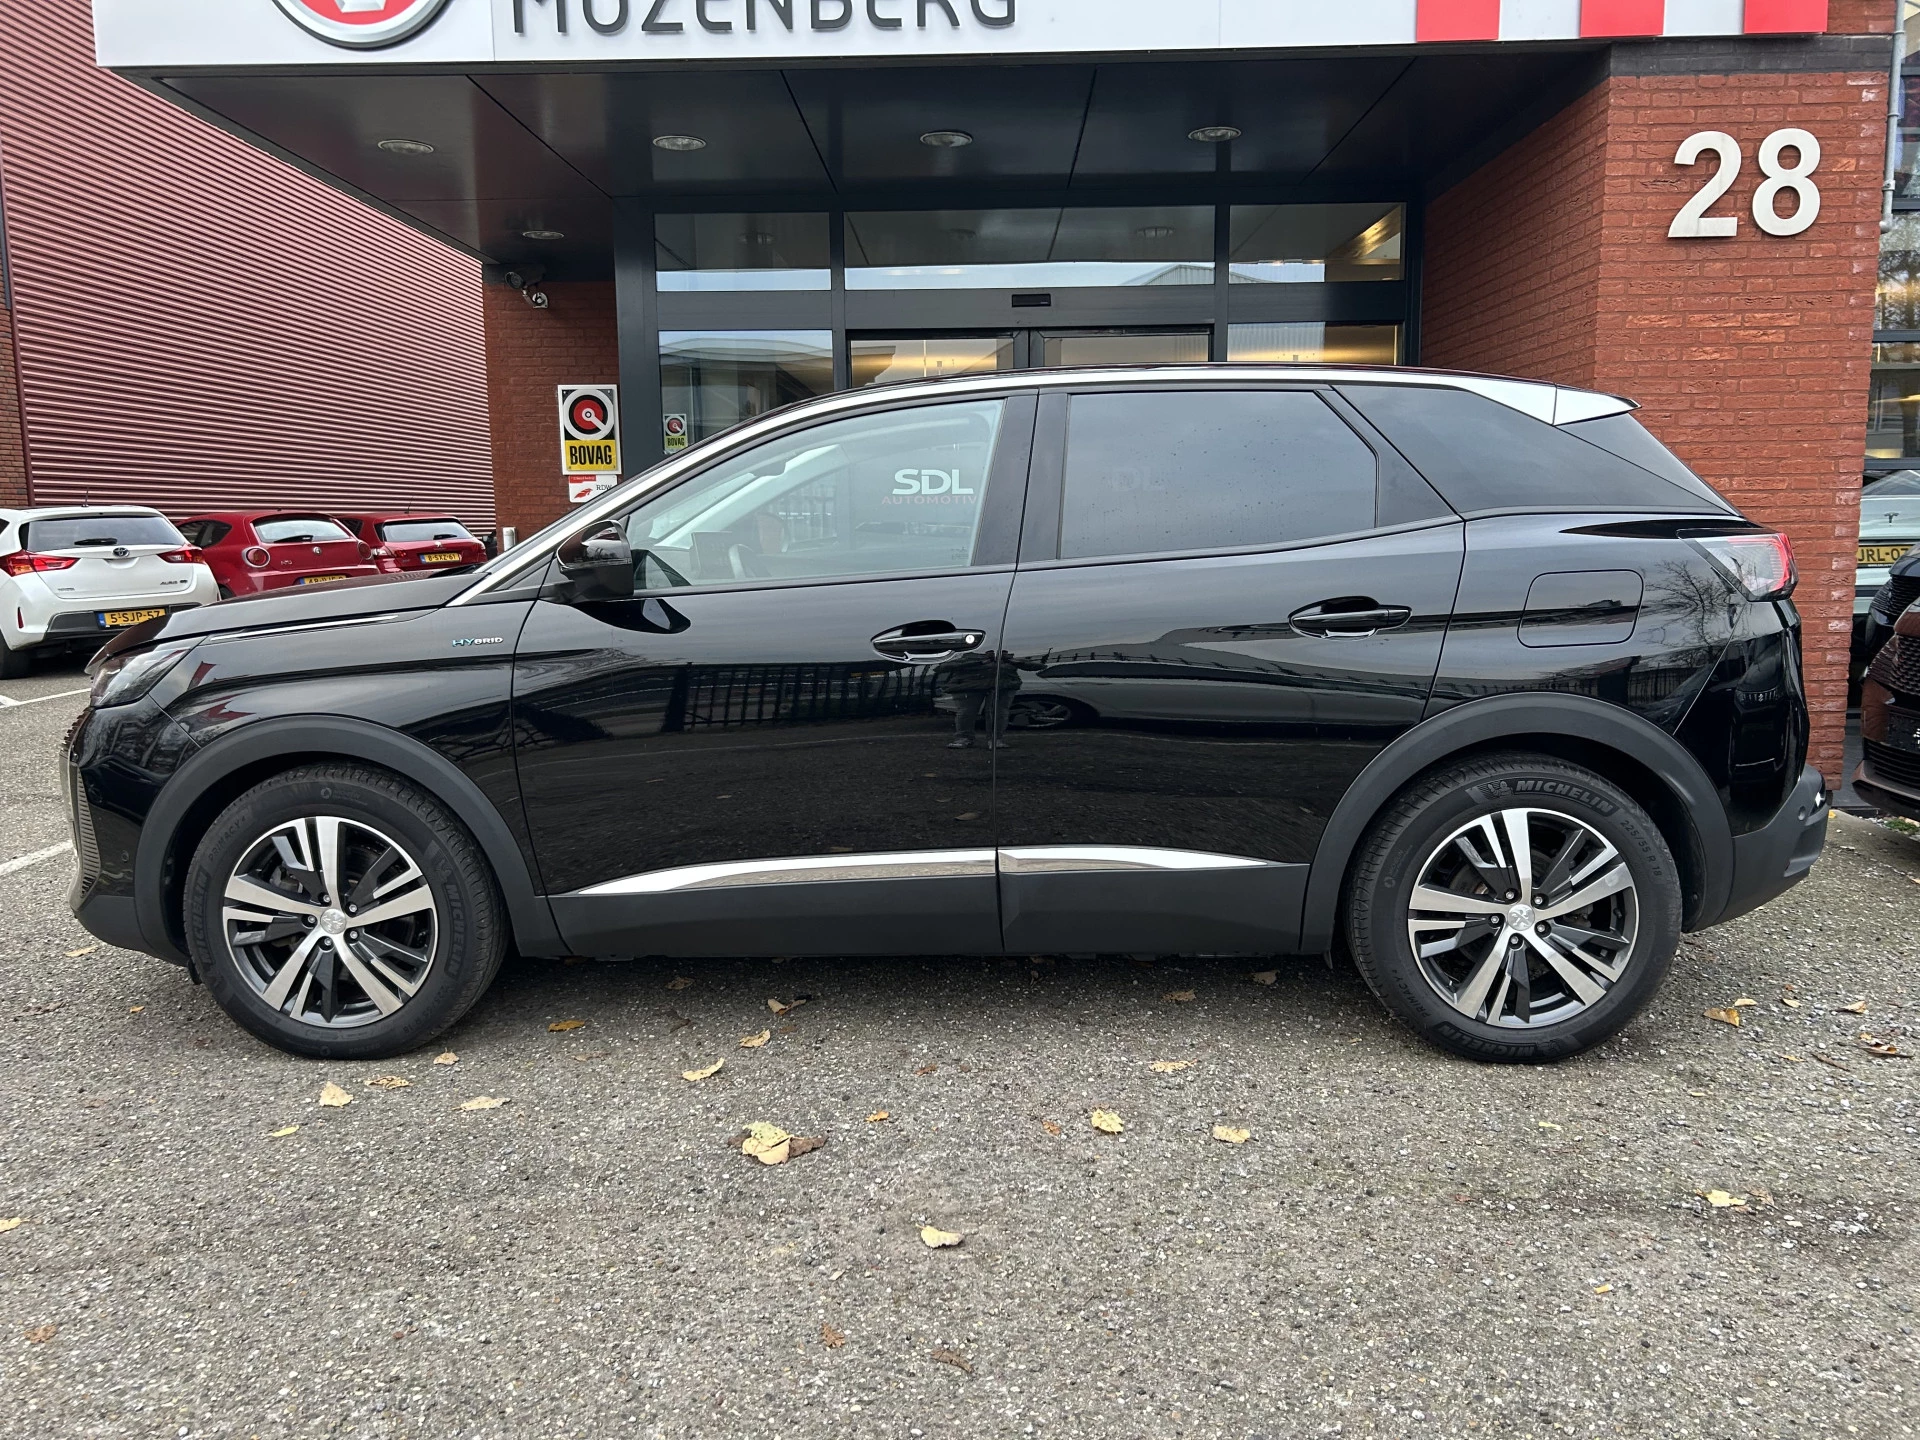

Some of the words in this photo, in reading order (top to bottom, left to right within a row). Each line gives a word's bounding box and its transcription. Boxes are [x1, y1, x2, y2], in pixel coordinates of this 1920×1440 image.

[1667, 127, 1820, 239] 28
[569, 445, 613, 465] BOVAG
[667, 437, 685, 447] BOVAG
[892, 468, 975, 495] SDL
[428, 553, 456, 562] 8-SXZ-61
[452, 637, 503, 647] HYBRID
[1515, 781, 1613, 814] MICHELIN
[1620, 820, 1651, 854] 225/55
[1645, 852, 1657, 863] R
[1651, 865, 1662, 877] 18
[192, 871, 211, 965] MICHELIN
[445, 883, 465, 976] MICHELIN
[1393, 975, 1431, 1019] PRIMACY
[1437, 1021, 1535, 1056] MICHELIN
